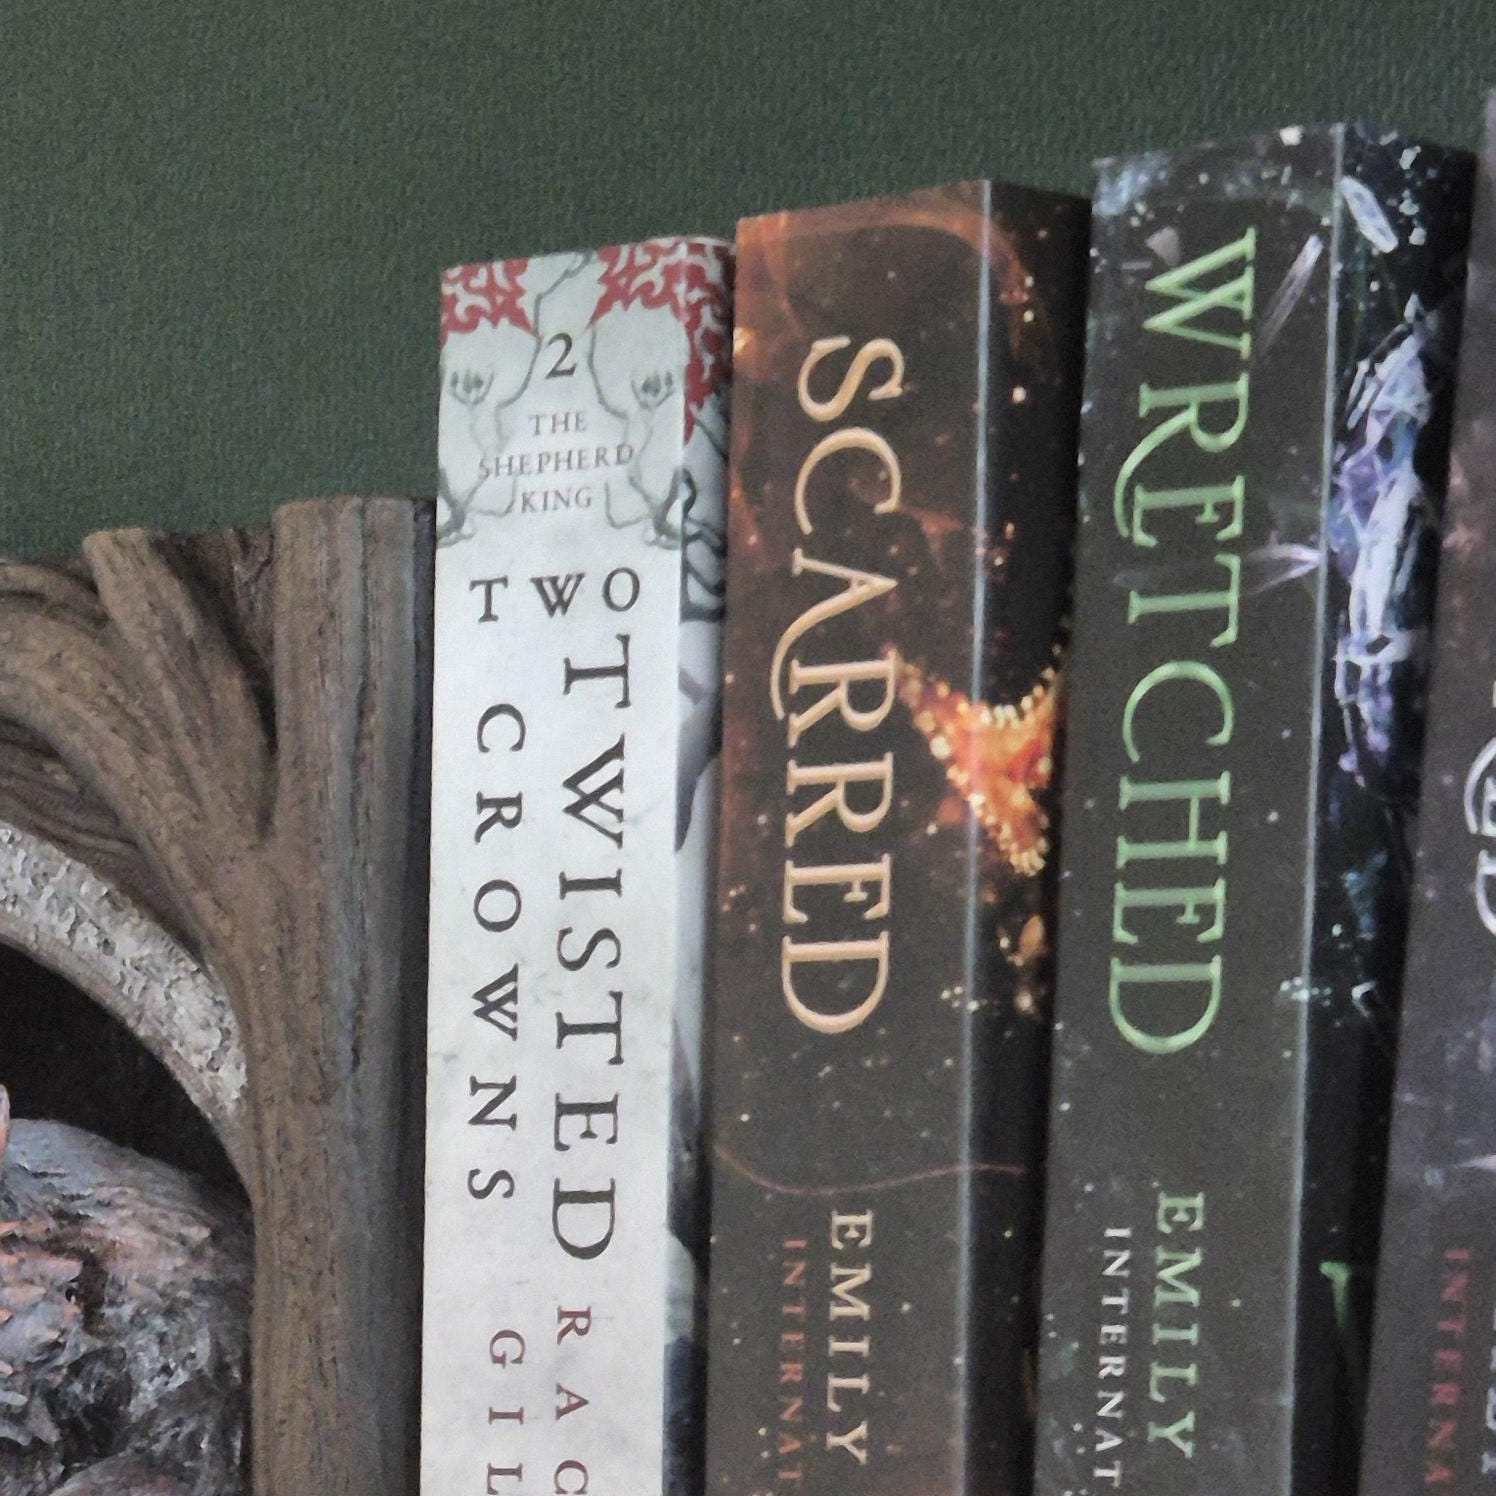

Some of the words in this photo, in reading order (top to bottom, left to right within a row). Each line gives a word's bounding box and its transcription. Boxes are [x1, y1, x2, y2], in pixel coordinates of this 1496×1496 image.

[477, 442, 635, 480] SHEPHERD
[527, 410, 588, 436] THE
[547, 331, 577, 379] 2
[469, 567, 641, 624] TWO
[520, 485, 593, 514] KING
[768, 335, 908, 1034] SCARRED
[1110, 226, 1259, 1055] WRETCHED
[466, 703, 527, 1201] CROWNS
[550, 633, 632, 1261] TWISTED
[824, 1208, 875, 1466] EMILY
[1146, 1191, 1207, 1461] EMILY
